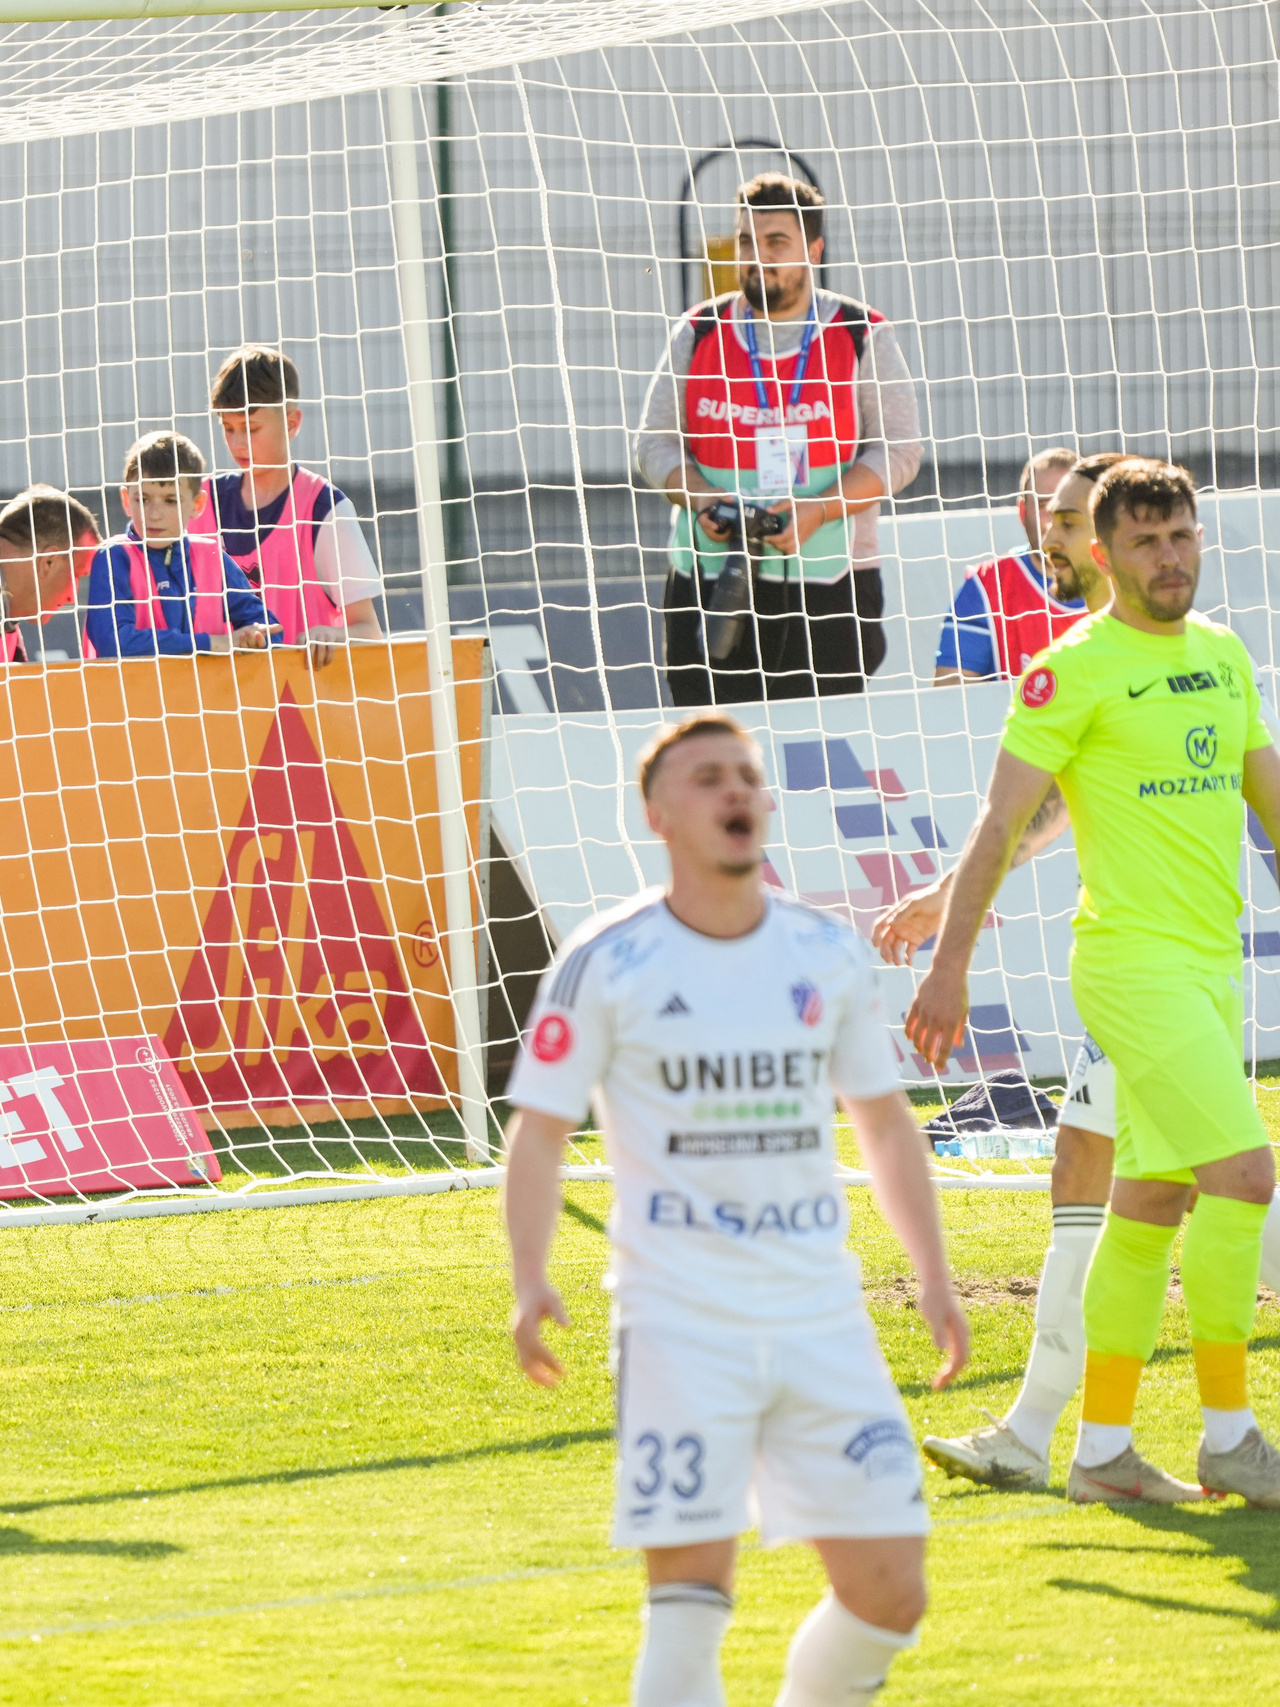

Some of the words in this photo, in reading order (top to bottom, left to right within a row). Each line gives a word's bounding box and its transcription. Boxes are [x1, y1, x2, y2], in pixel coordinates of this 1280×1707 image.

[697, 397, 832, 427] SUPERLIGA
[1139, 774, 1227, 798] MOZZART
[659, 1048, 824, 1093] UNIBET
[648, 1190, 840, 1237] ELSACO
[633, 1430, 706, 1500] 33
